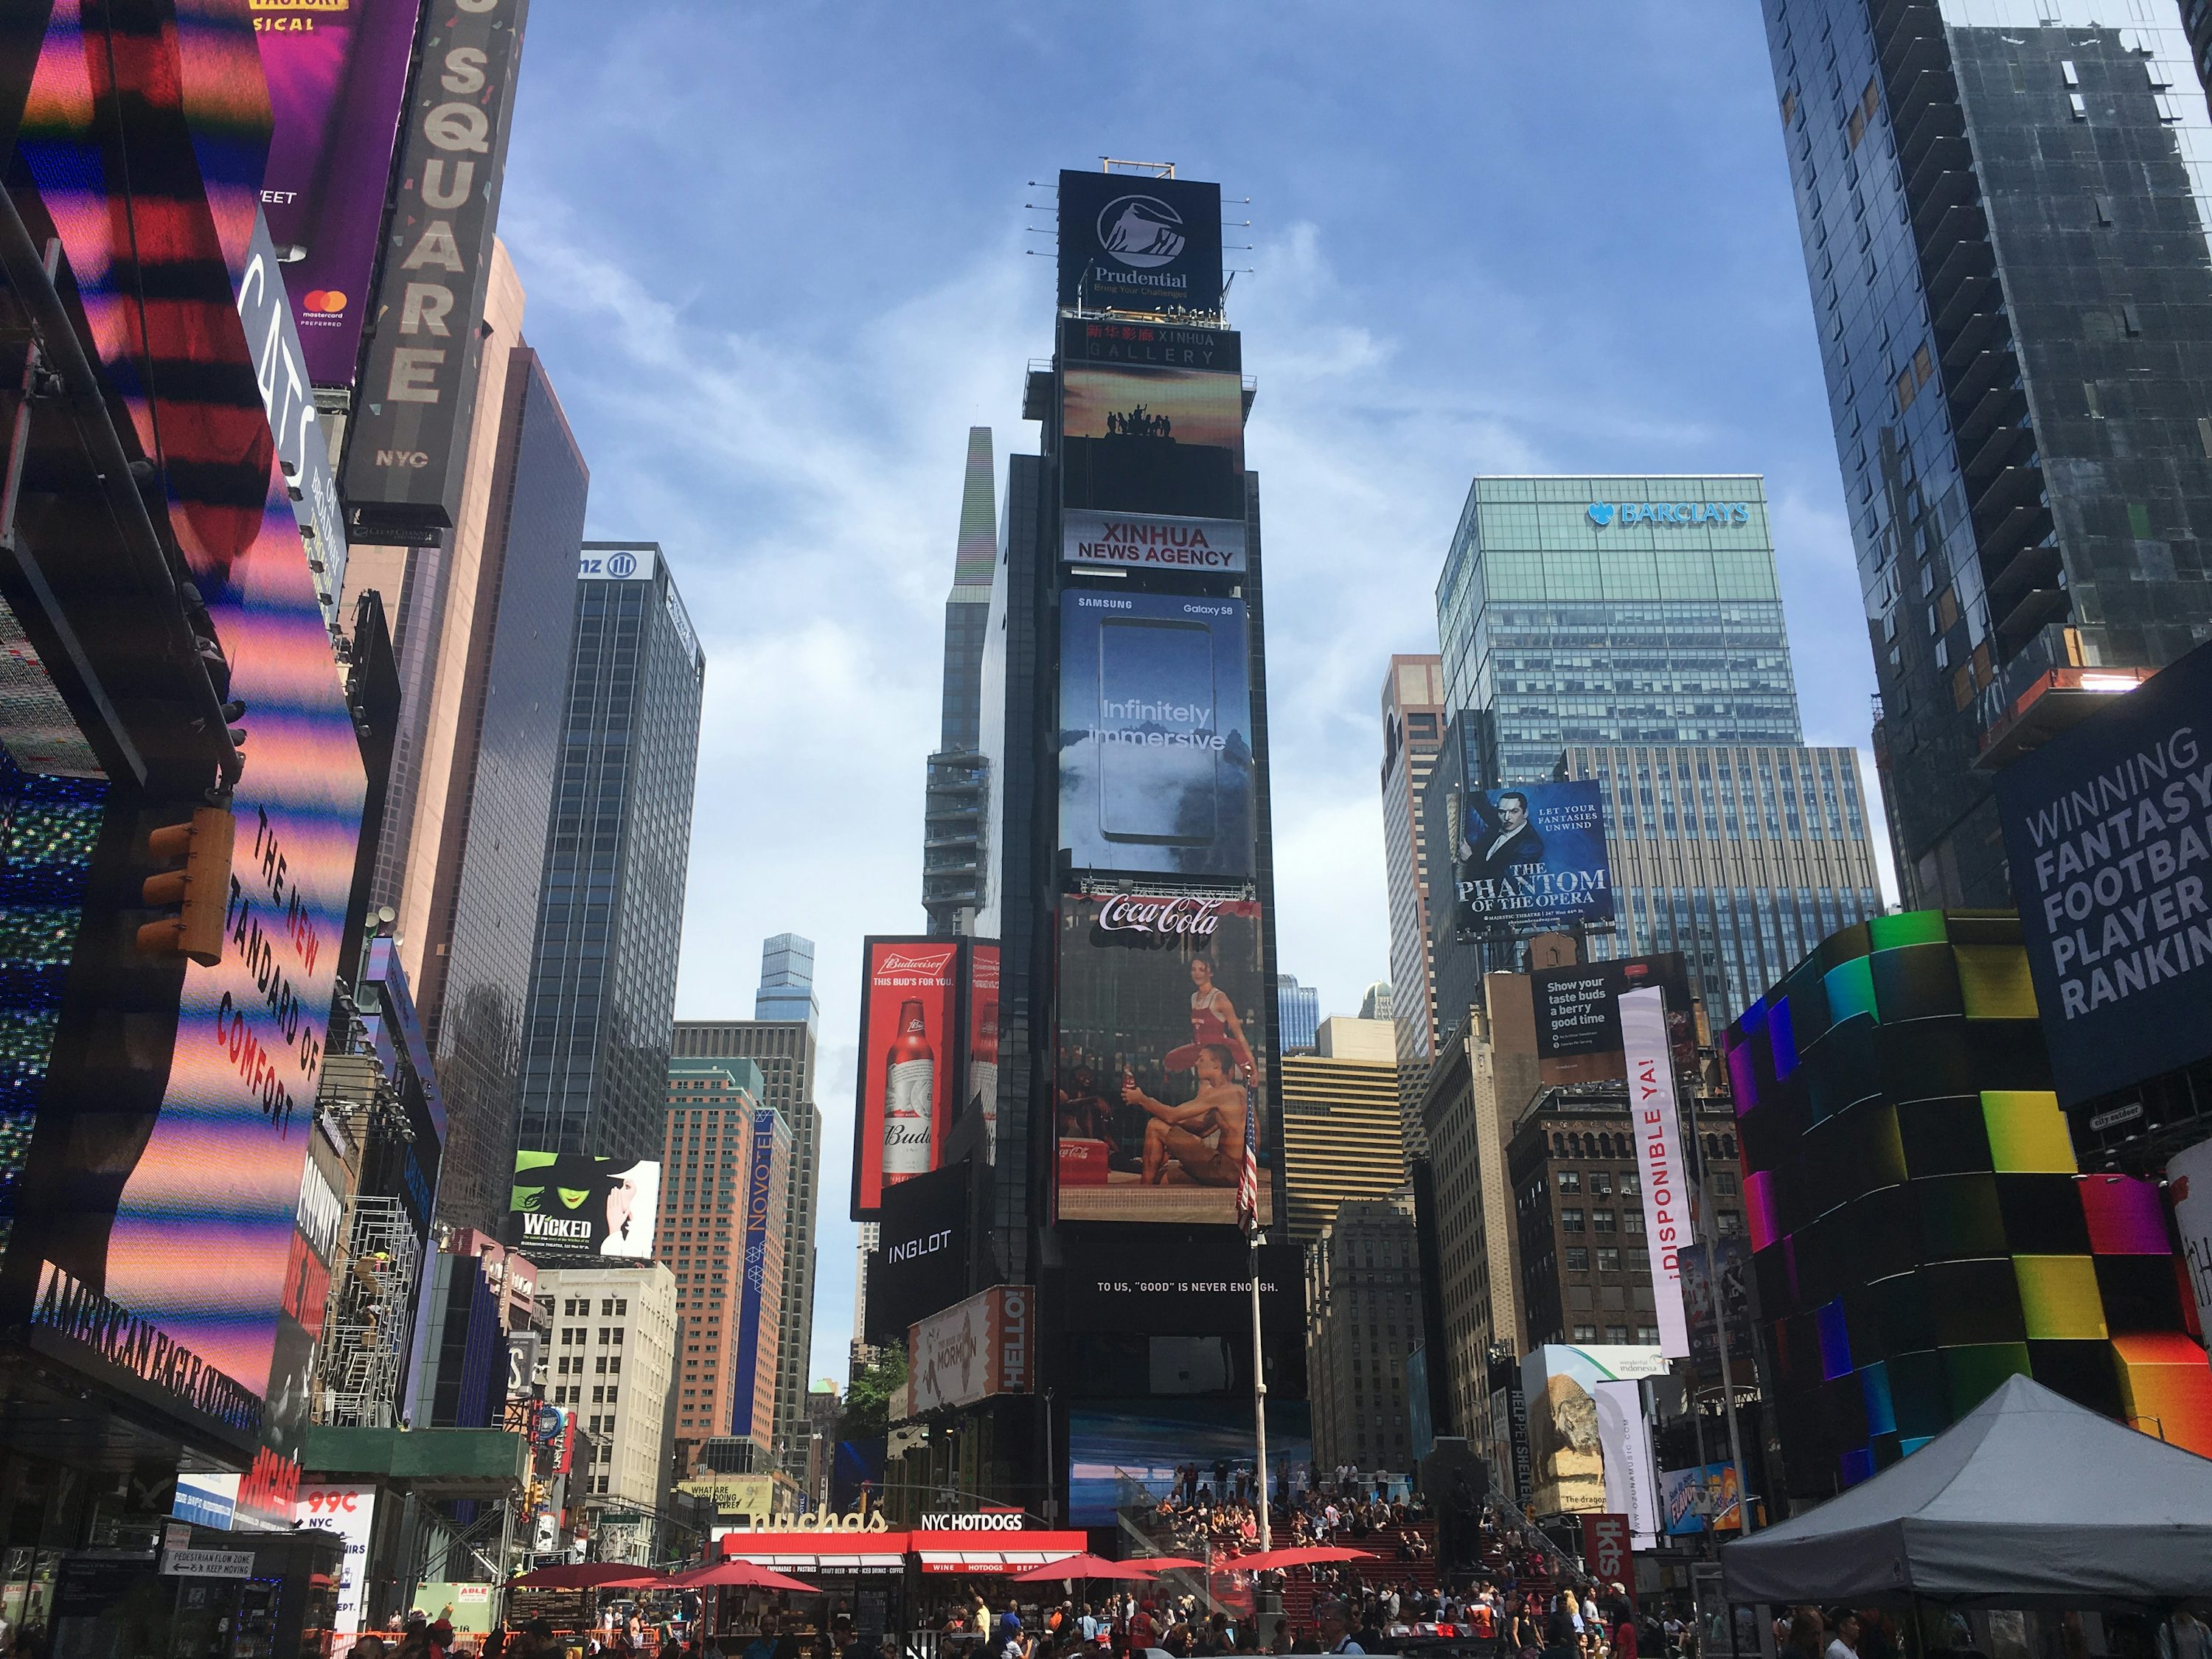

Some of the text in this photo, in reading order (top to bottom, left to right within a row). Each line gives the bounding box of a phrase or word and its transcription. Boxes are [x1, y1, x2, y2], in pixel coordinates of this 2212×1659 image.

[253, 17, 313, 31] SICAL
[387, 46, 490, 403] SQUARE
[1095, 266, 1188, 288] Prudential
[1094, 283, 1189, 299] Bring Your Challenges
[1158, 330, 1214, 347] XINHUA
[1090, 342, 1214, 366] GALLERY
[237, 253, 315, 489] CATS
[375, 449, 429, 468] NYC
[327, 478, 337, 518] ON
[310, 465, 341, 577] BROADWAY
[1621, 501, 1750, 524] BARCLAYS
[1102, 522, 1210, 549] XINHUA
[1078, 542, 1233, 568] NEWS AGENCY
[1078, 597, 1133, 610] SAMSUNG
[1183, 604, 1234, 616] Galaxy S8
[1103, 699, 1211, 729] Infinitely
[1088, 724, 1227, 751] immersive
[2025, 726, 2199, 849] WINNING
[1537, 812, 1599, 824] FANTASIES
[1539, 804, 1596, 817] LET YOUR
[1545, 821, 1592, 832] UNWIND
[2034, 762, 2212, 892] FANTASY
[254, 803, 288, 908] THE
[1509, 862, 1548, 877] THE
[1455, 869, 1607, 902] PHANTOM
[1471, 891, 1595, 913] OF THE OPERA
[1099, 893, 1225, 936] Coca-Cola
[2052, 874, 2211, 978] PLAYER
[286, 883, 319, 978] NEW
[884, 957, 944, 970] Budweiser
[226, 872, 319, 1082] TANDARD OF
[873, 978, 954, 987] THIS BUD'S FOR YOU.
[1547, 977, 1605, 993] Show your
[1548, 989, 1606, 1005] taste buds
[1550, 1003, 1592, 1016] a berry
[1551, 1014, 1605, 1031] good time
[217, 990, 293, 1141] COMFORT
[1638, 1060, 1658, 1101] YA!
[2095, 1105, 2140, 1128] city outdoor
[748, 1121, 774, 1233] NOVOTEL
[1644, 1108, 1681, 1280] ¡DISPONIBLE
[887, 1229, 952, 1265] INGLOT
[1097, 1281, 1279, 1293] TO US, “GOOD” IS NEVER ENOGH.
[29, 1258, 156, 1383] AMERICAN
[151, 1330, 204, 1410] EAGLE
[1004, 1290, 1026, 1388] HELLO!
[1620, 1364, 1657, 1372] indonesia
[308, 1491, 359, 1512] 99¢
[1579, 1496, 1607, 1505] dragon
[309, 1518, 333, 1528] NYC
[750, 1502, 888, 1534] nuchas
[922, 1514, 1023, 1531] NYC HOTDOGS
[174, 1551, 251, 1565] PEDESTRIAN FLOW ZONE
[1595, 1519, 1622, 1578] tkts
[206, 1563, 249, 1575] KEEP MOVING
[968, 1564, 1004, 1572] HOTDOGS
